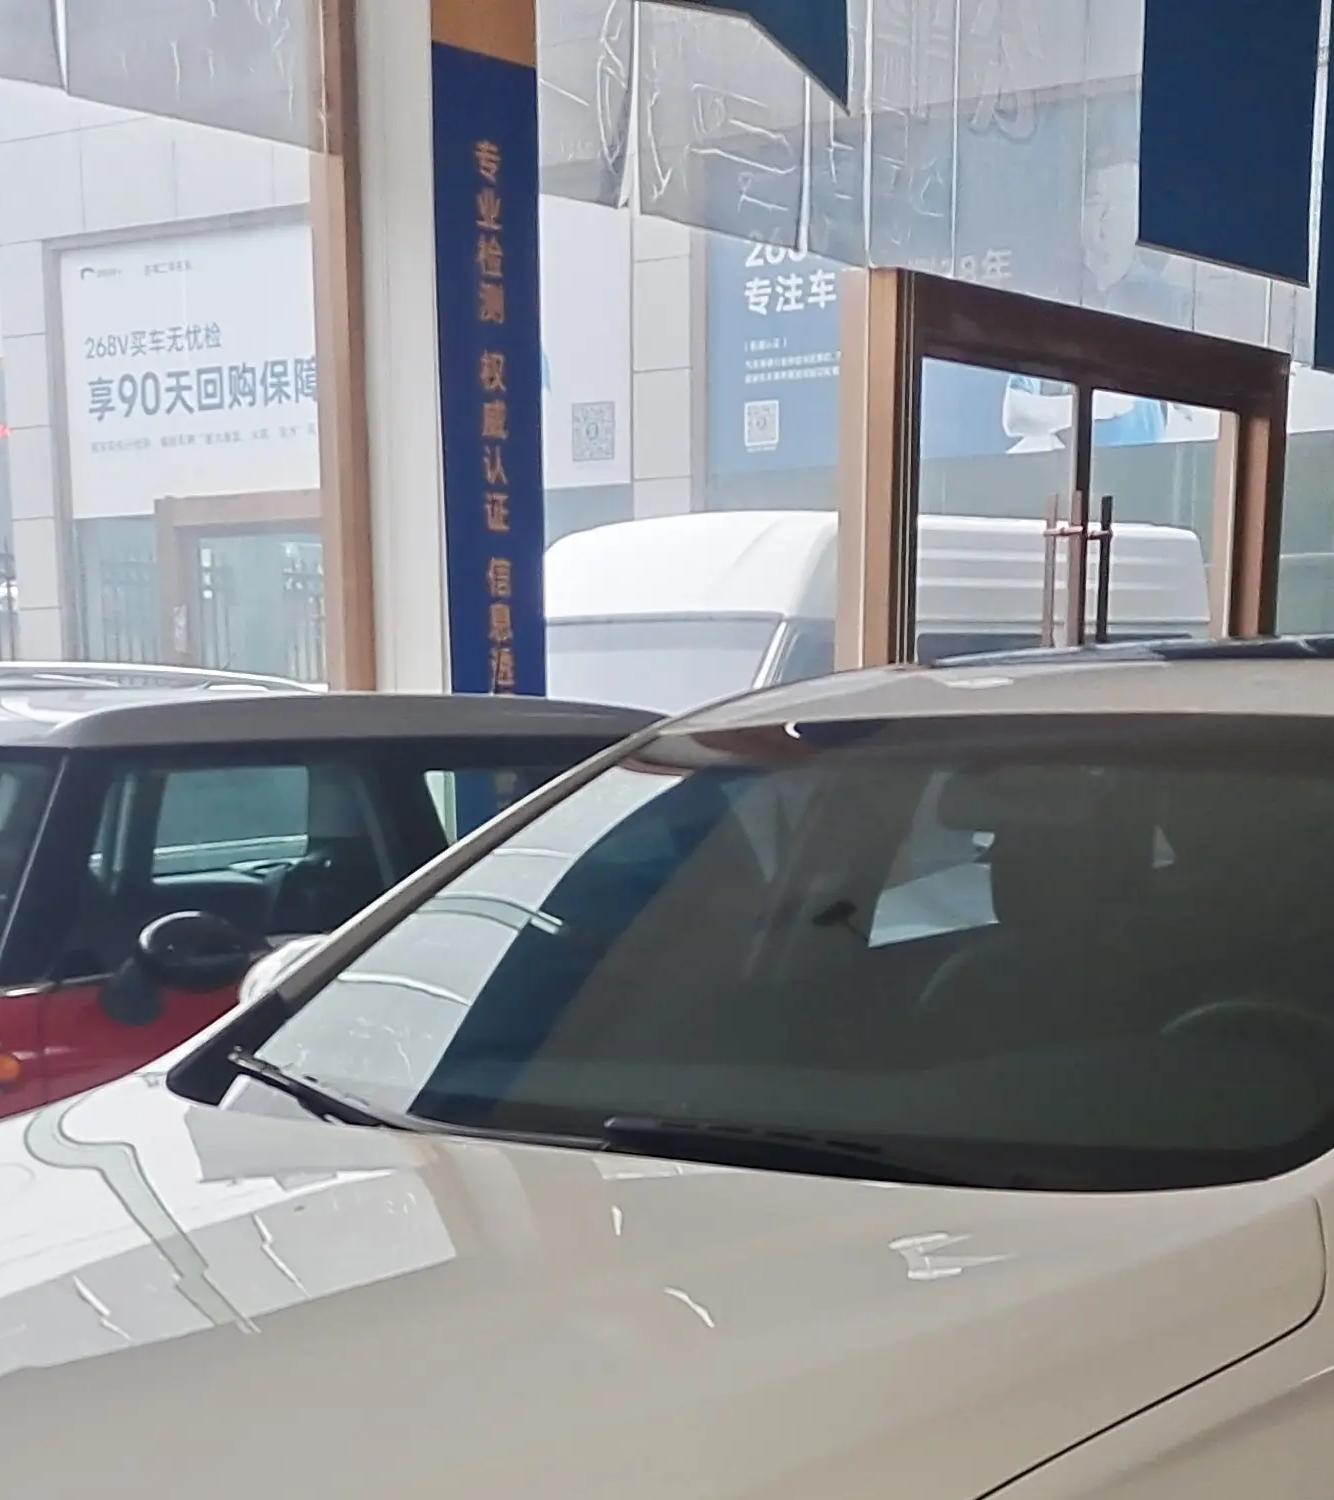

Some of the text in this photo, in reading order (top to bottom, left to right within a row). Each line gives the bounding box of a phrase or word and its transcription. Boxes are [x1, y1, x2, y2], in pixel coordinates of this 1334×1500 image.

[474, 138, 506, 324] 专业检测
[743, 268, 837, 317] 专注车
[480, 349, 511, 533] 权威认证
